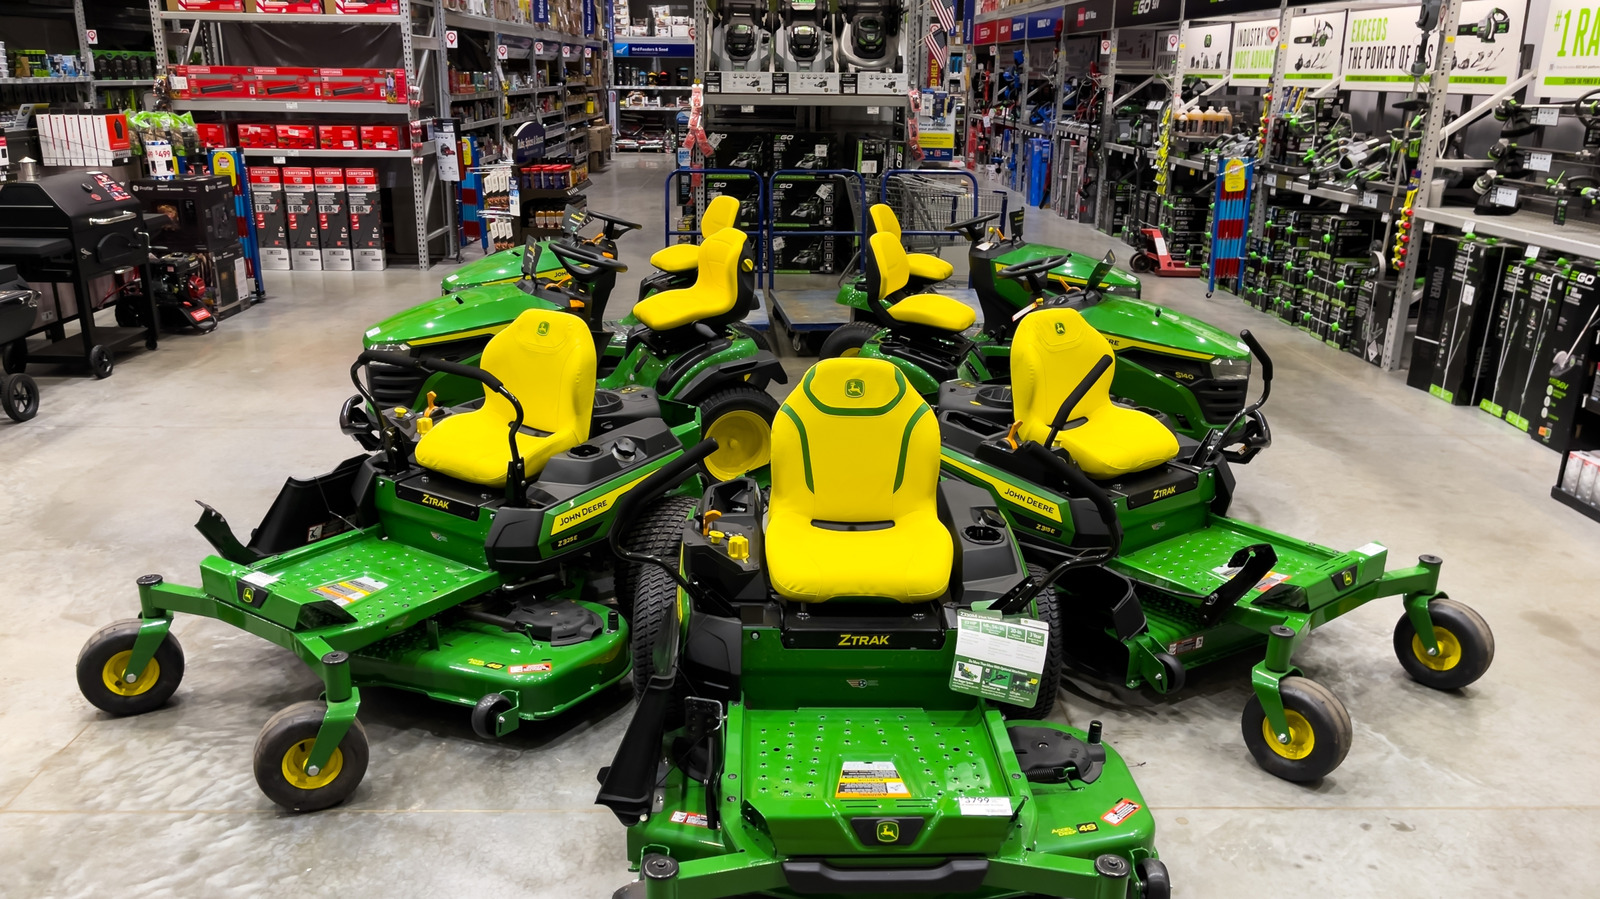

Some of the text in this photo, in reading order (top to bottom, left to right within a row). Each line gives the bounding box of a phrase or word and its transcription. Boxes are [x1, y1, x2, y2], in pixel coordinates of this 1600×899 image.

[1351, 17, 1388, 43] EXCEEDS
[1554, 9, 1572, 57] #1
[1234, 49, 1276, 70] MOST ADVANC
[1348, 46, 1362, 70] THE
[1364, 45, 1395, 70] POWER
[1398, 44, 1411, 70] OF
[930, 59, 938, 78] HELP
[1458, 241, 1476, 253] EGO
[1506, 264, 1525, 276] EGO
[1534, 272, 1552, 284] EGO
[1570, 269, 1596, 286] EGO
[1429, 266, 1446, 300] POWER
[1174, 371, 1195, 380] S140
[422, 493, 450, 510] ZTRAK
[1004, 487, 1055, 515] JOHN DEERE
[1153, 485, 1176, 500] ZTRAK
[559, 499, 608, 527] JOHN DEERE
[837, 634, 891, 646] ZTRAK
